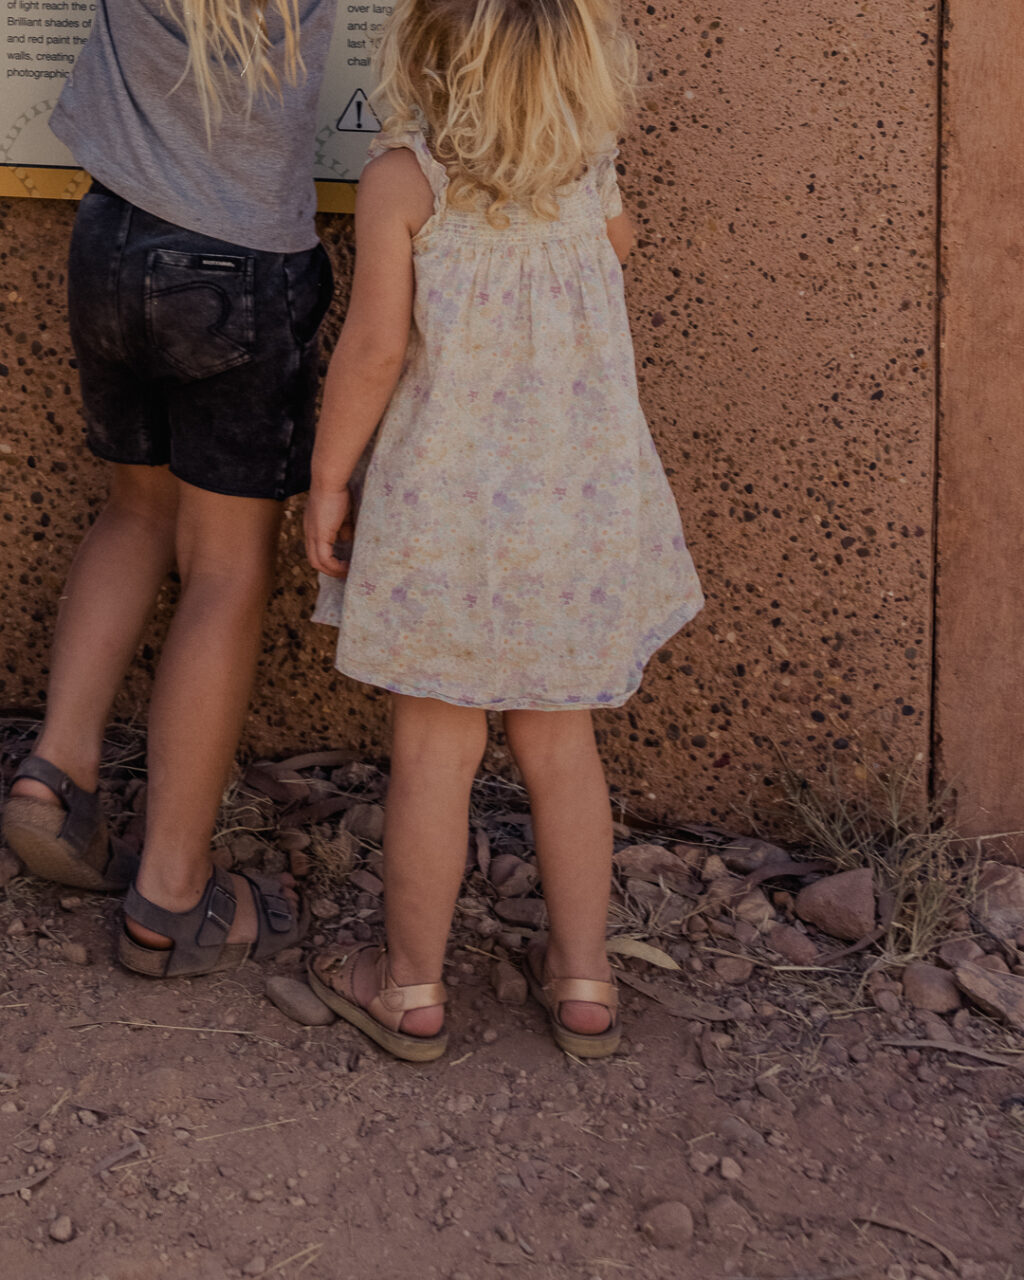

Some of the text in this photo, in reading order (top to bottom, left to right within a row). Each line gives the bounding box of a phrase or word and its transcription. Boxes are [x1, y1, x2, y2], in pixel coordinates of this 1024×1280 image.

[7, 0, 17, 10] of
[19, 1, 39, 12] light
[41, 1, 69, 11] reach
[71, 2, 87, 11] the
[347, 4, 370, 13] over
[7, 16, 42, 27] Brilliant
[44, 18, 80, 28] shades
[347, 21, 368, 31] and
[7, 34, 25, 44] and
[27, 35, 44, 44] red
[46, 35, 70, 45] paint
[347, 38, 366, 49] last
[7, 51, 75, 64] walls, creating
